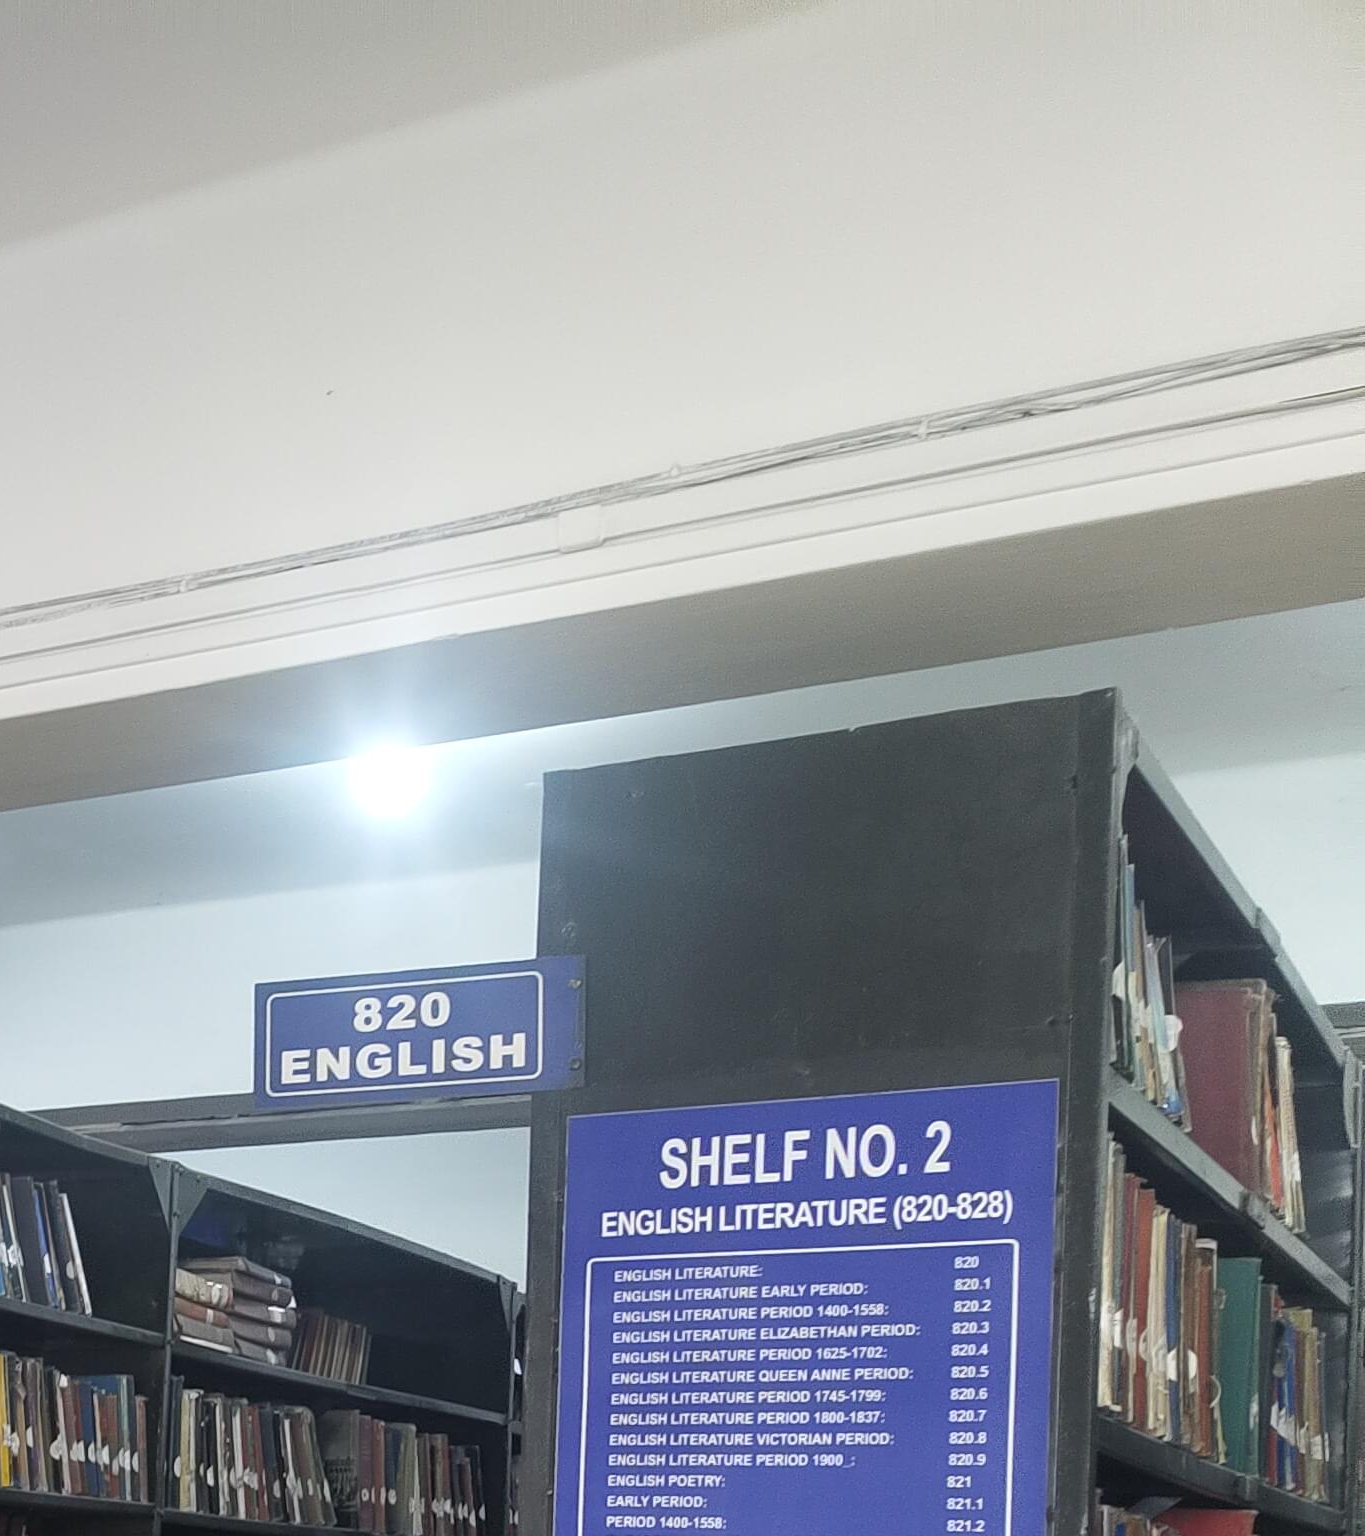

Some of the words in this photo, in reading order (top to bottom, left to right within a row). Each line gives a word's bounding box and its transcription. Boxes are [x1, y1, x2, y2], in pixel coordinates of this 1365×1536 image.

[353, 991, 451, 1032] 820
[280, 1033, 526, 1084] ENGLISH
[659, 1129, 810, 1188] SHELF
[825, 1124, 907, 1179] NO.
[923, 1120, 950, 1173] 2
[601, 1206, 712, 1237] ENGLISH
[719, 1196, 886, 1231] LITERATURE
[892, 1189, 1012, 1229] (820-828)
[953, 1255, 979, 1269] 820
[613, 1267, 671, 1282] ENGLISH
[953, 1276, 990, 1291] 820.1
[613, 1288, 671, 1303] ENGLISH
[674, 1285, 758, 1301] LITERATURE
[760, 1283, 806, 1298] EARLY
[809, 1282, 868, 1296] PERIOD:
[612, 1309, 670, 1323] ENGLISH
[673, 1306, 757, 1321] LITERATURE
[760, 1305, 813, 1319] PERIOD
[816, 1302, 888, 1317] 1400-1558:
[953, 1298, 991, 1313] 820.2
[612, 1329, 670, 1343] ENGLISH
[673, 1327, 757, 1342] LITERATURE
[759, 1324, 858, 1340] ELIZABETHAN
[860, 1323, 920, 1337] PERIOD:
[951, 1320, 989, 1334] 820.3
[611, 1350, 669, 1364] ENGLISH
[672, 1348, 756, 1363] LITERATURE
[759, 1347, 812, 1361] PERIOD
[815, 1345, 887, 1359] 1625-1702:
[950, 1343, 989, 1356] 820.4
[611, 1371, 669, 1384] ENGLISH
[671, 1369, 755, 1383] LITERATURE
[758, 1368, 807, 1382] QUEEN
[809, 1367, 851, 1381] ANNE
[853, 1366, 913, 1380] PERIOD:
[950, 1364, 989, 1378] 820.5
[610, 1392, 668, 1405] ENGLISH
[671, 1390, 755, 1404] LITERATURE
[757, 1389, 810, 1403] PERIOD
[813, 1388, 886, 1402] 1745-1799:
[949, 1386, 988, 1400] 820.6
[609, 1412, 667, 1425] ENGLISH
[670, 1411, 754, 1425] LITERATURE
[756, 1411, 810, 1424] PERIOD
[813, 1410, 885, 1424] 1800-1837:
[948, 1408, 987, 1422] 820.7
[608, 1433, 666, 1446] ENGLISH
[669, 1432, 753, 1445] LITERATURE
[756, 1432, 832, 1445] VICTORIAN
[835, 1432, 894, 1445] PERIOD:
[948, 1431, 987, 1444] 820.8
[608, 1453, 666, 1466] ENGLISH
[668, 1453, 753, 1466] LITERATURE
[755, 1453, 808, 1466] PERIOD
[947, 1452, 986, 1466] 820.9
[607, 1473, 665, 1487] ENGLISH
[668, 1474, 725, 1487] POETRY:
[946, 1475, 971, 1488] 821
[606, 1494, 650, 1507] EARLY
[652, 1495, 707, 1508] PERIOD:
[946, 1497, 983, 1510] 821.1
[605, 1515, 656, 1528] PERIOD
[659, 1515, 726, 1529] 1400-1558:
[946, 1519, 985, 1532] 821.2
